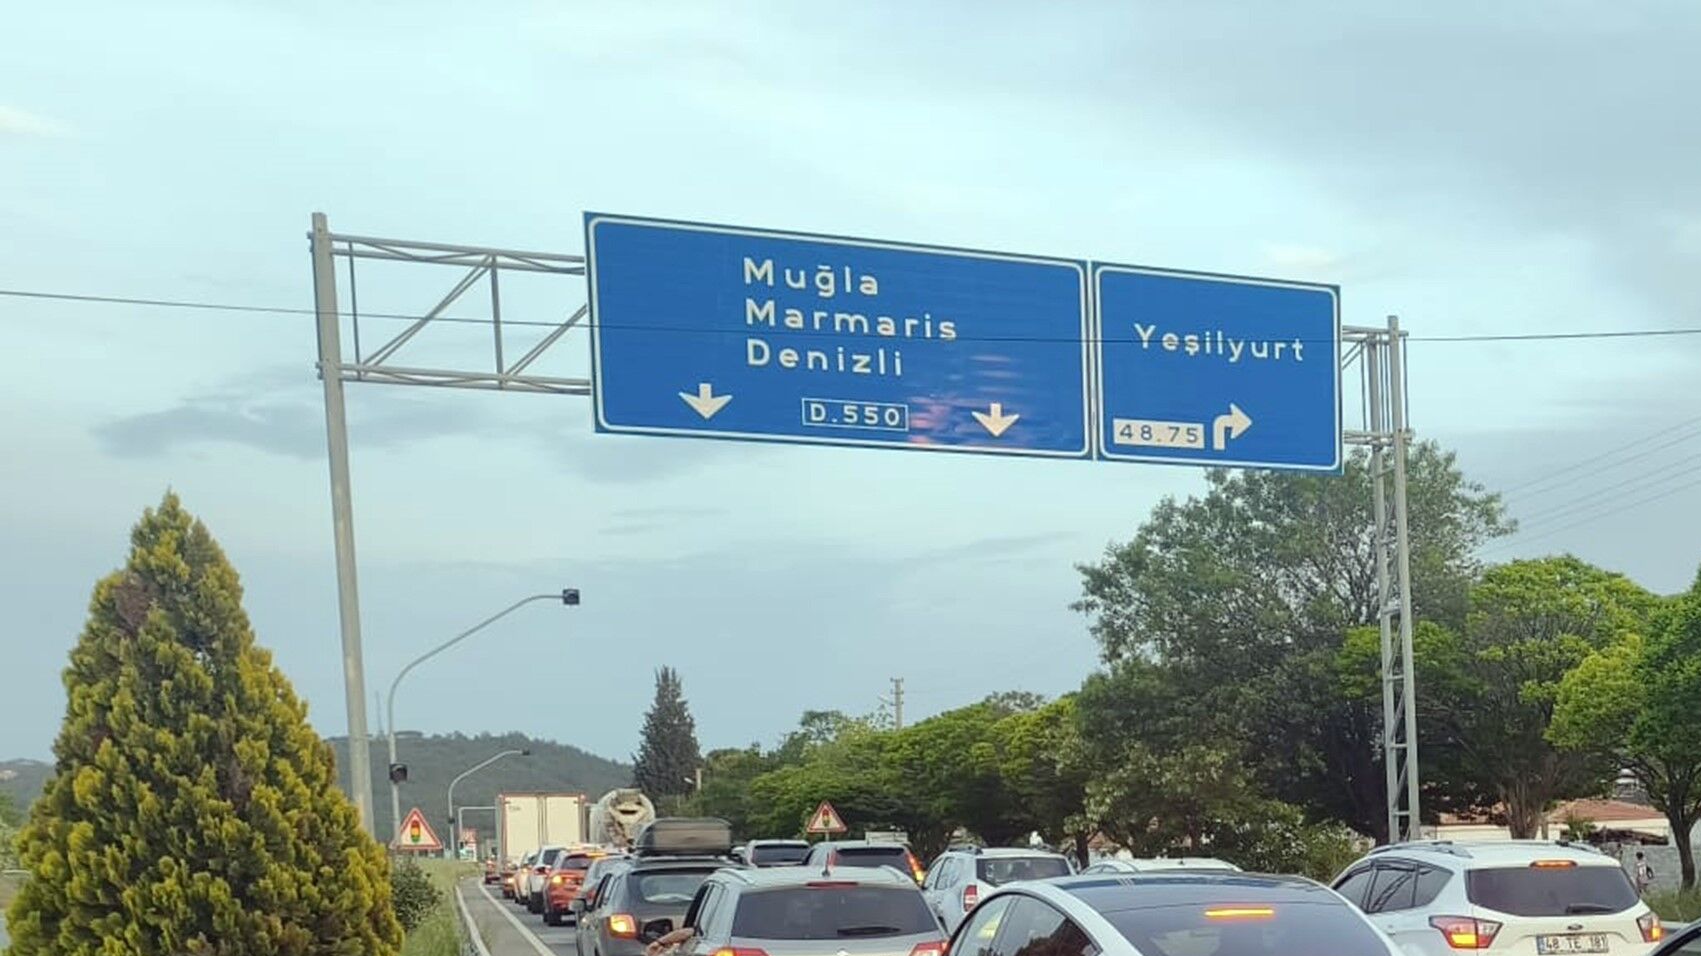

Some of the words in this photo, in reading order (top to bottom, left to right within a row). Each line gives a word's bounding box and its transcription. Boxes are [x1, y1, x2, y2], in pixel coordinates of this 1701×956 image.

[743, 256, 878, 297] Muğla
[745, 298, 957, 339] Marmaris
[747, 338, 902, 376] Denizli
[1134, 323, 1303, 362] Yeşilyurt
[810, 402, 900, 426] D.550
[1119, 424, 1199, 444] 48.75
